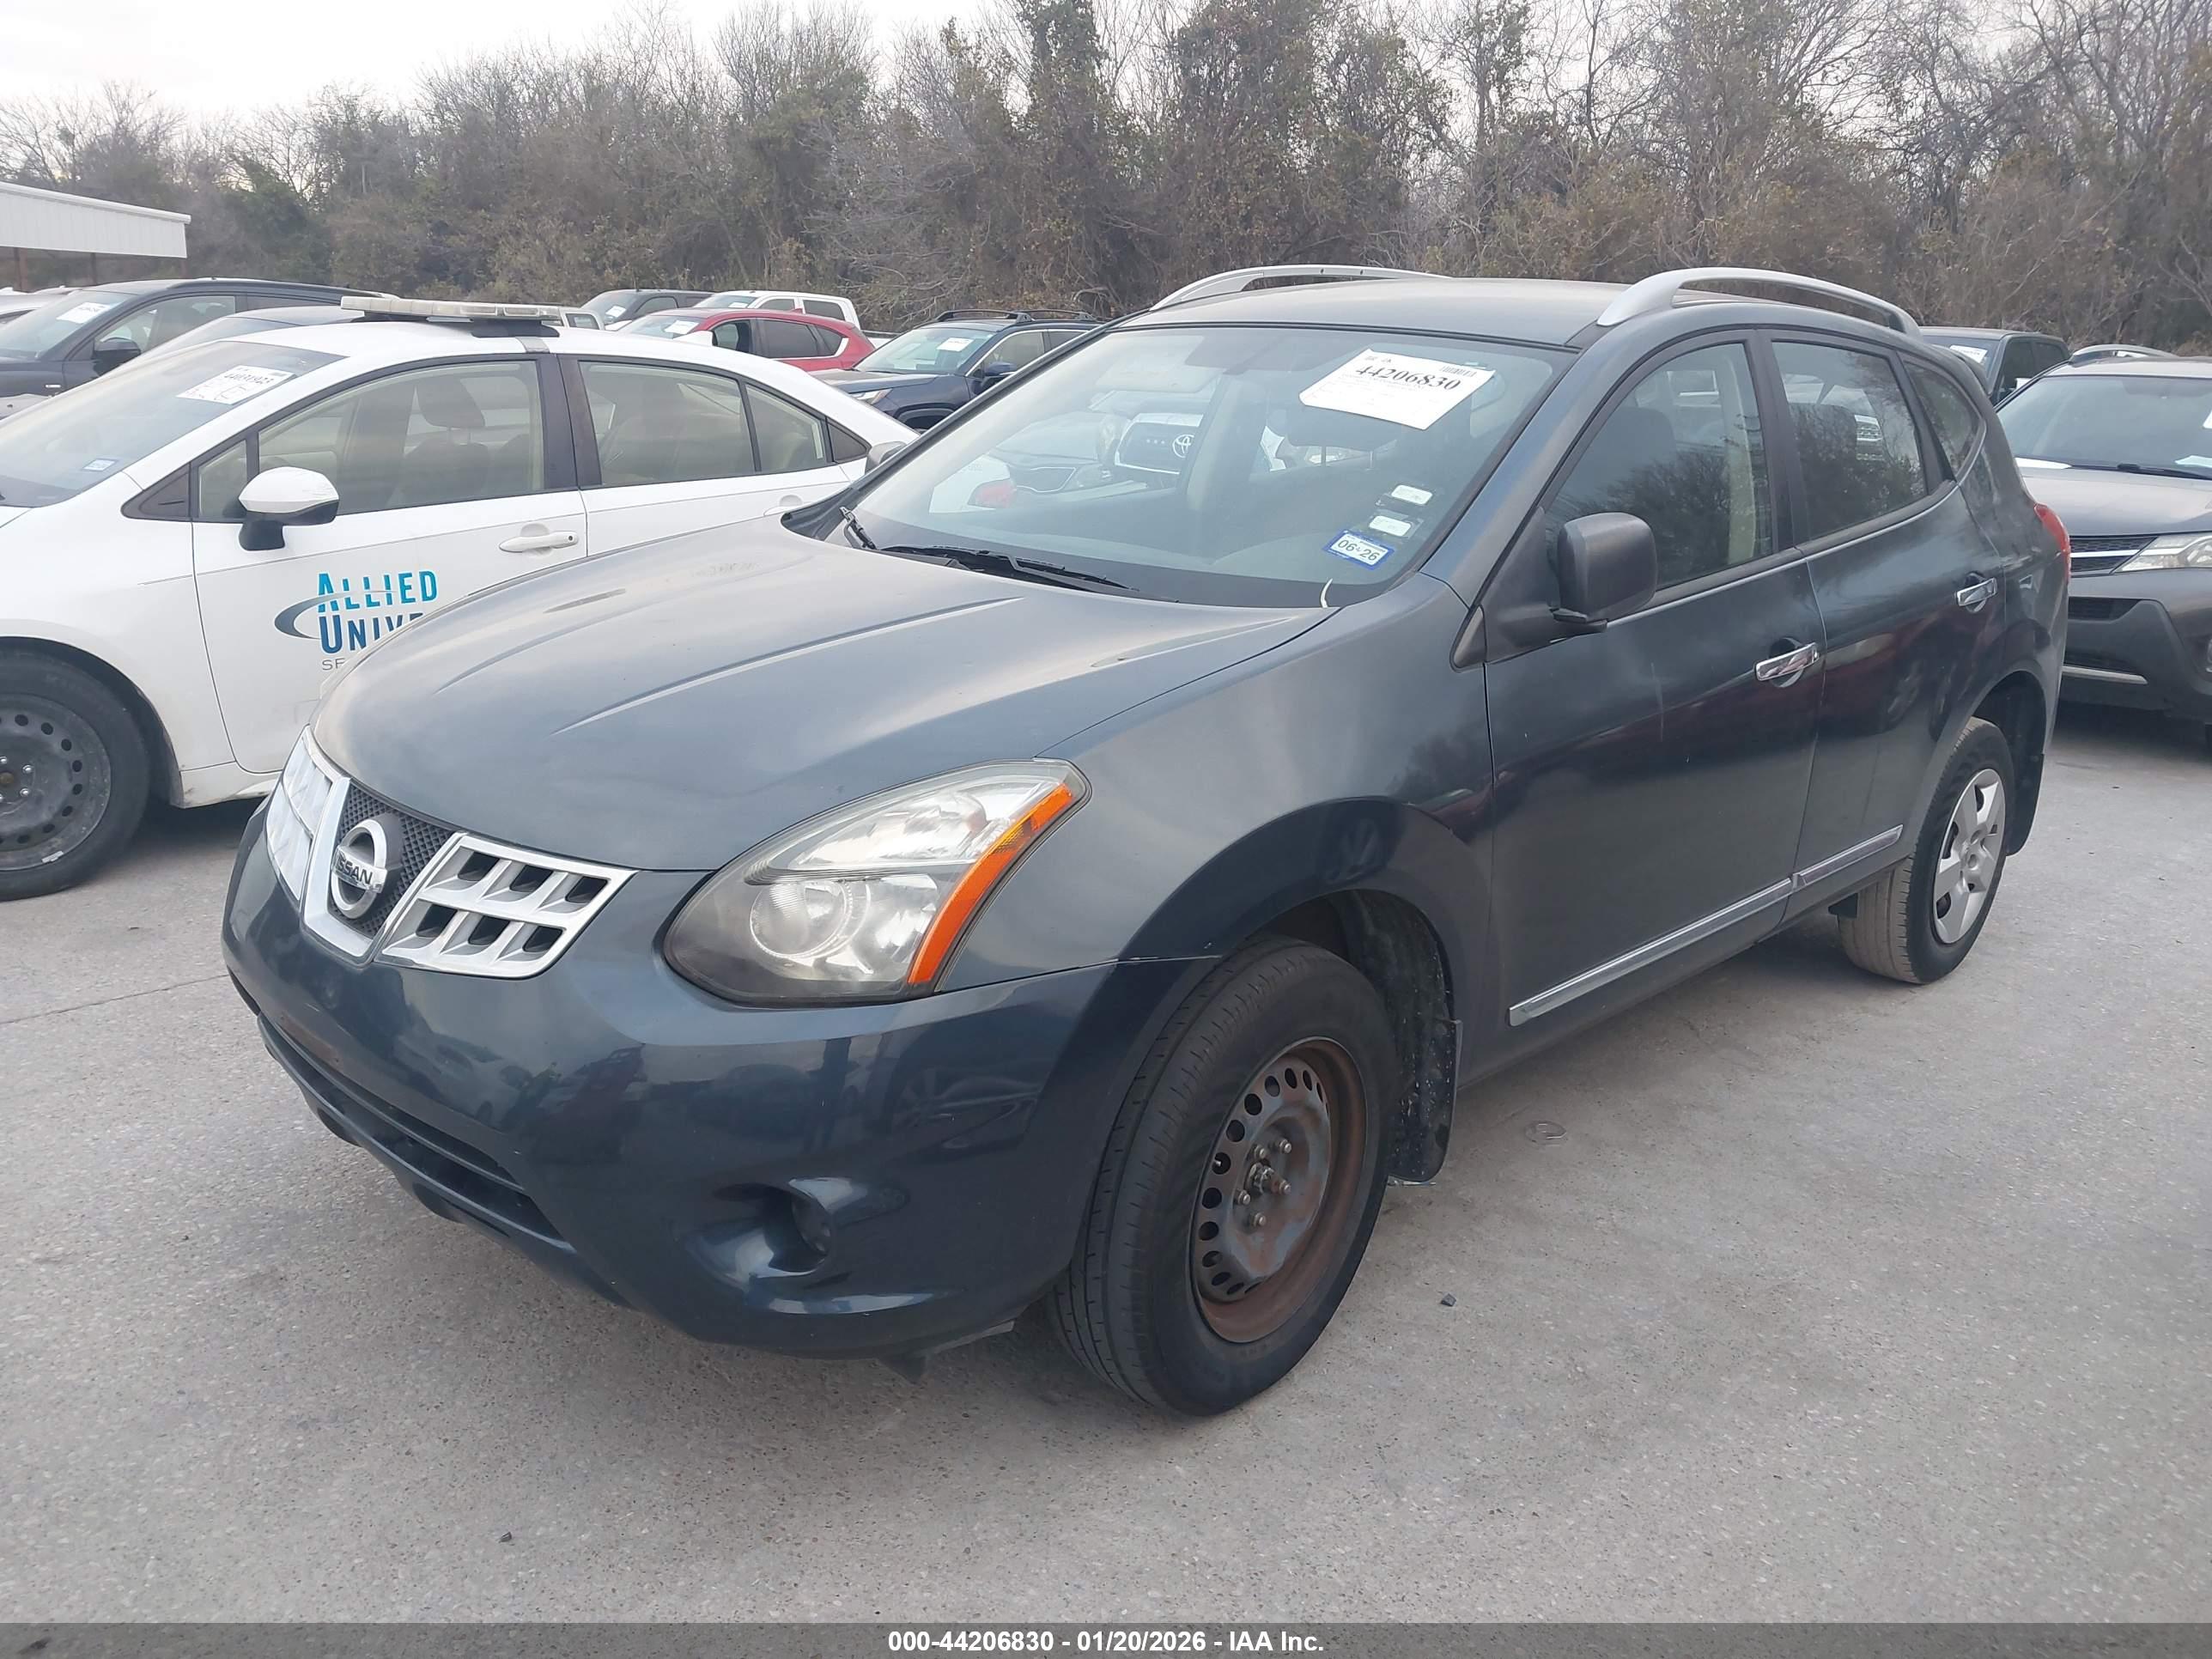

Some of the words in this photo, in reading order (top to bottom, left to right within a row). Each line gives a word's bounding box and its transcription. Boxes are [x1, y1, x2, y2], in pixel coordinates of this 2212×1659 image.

[1356, 365, 1462, 391] 44206830
[1338, 539, 1358, 552] 06
[1360, 549, 1380, 561] 26
[317, 570, 438, 613] ALLIED
[333, 850, 374, 885] SSAN
